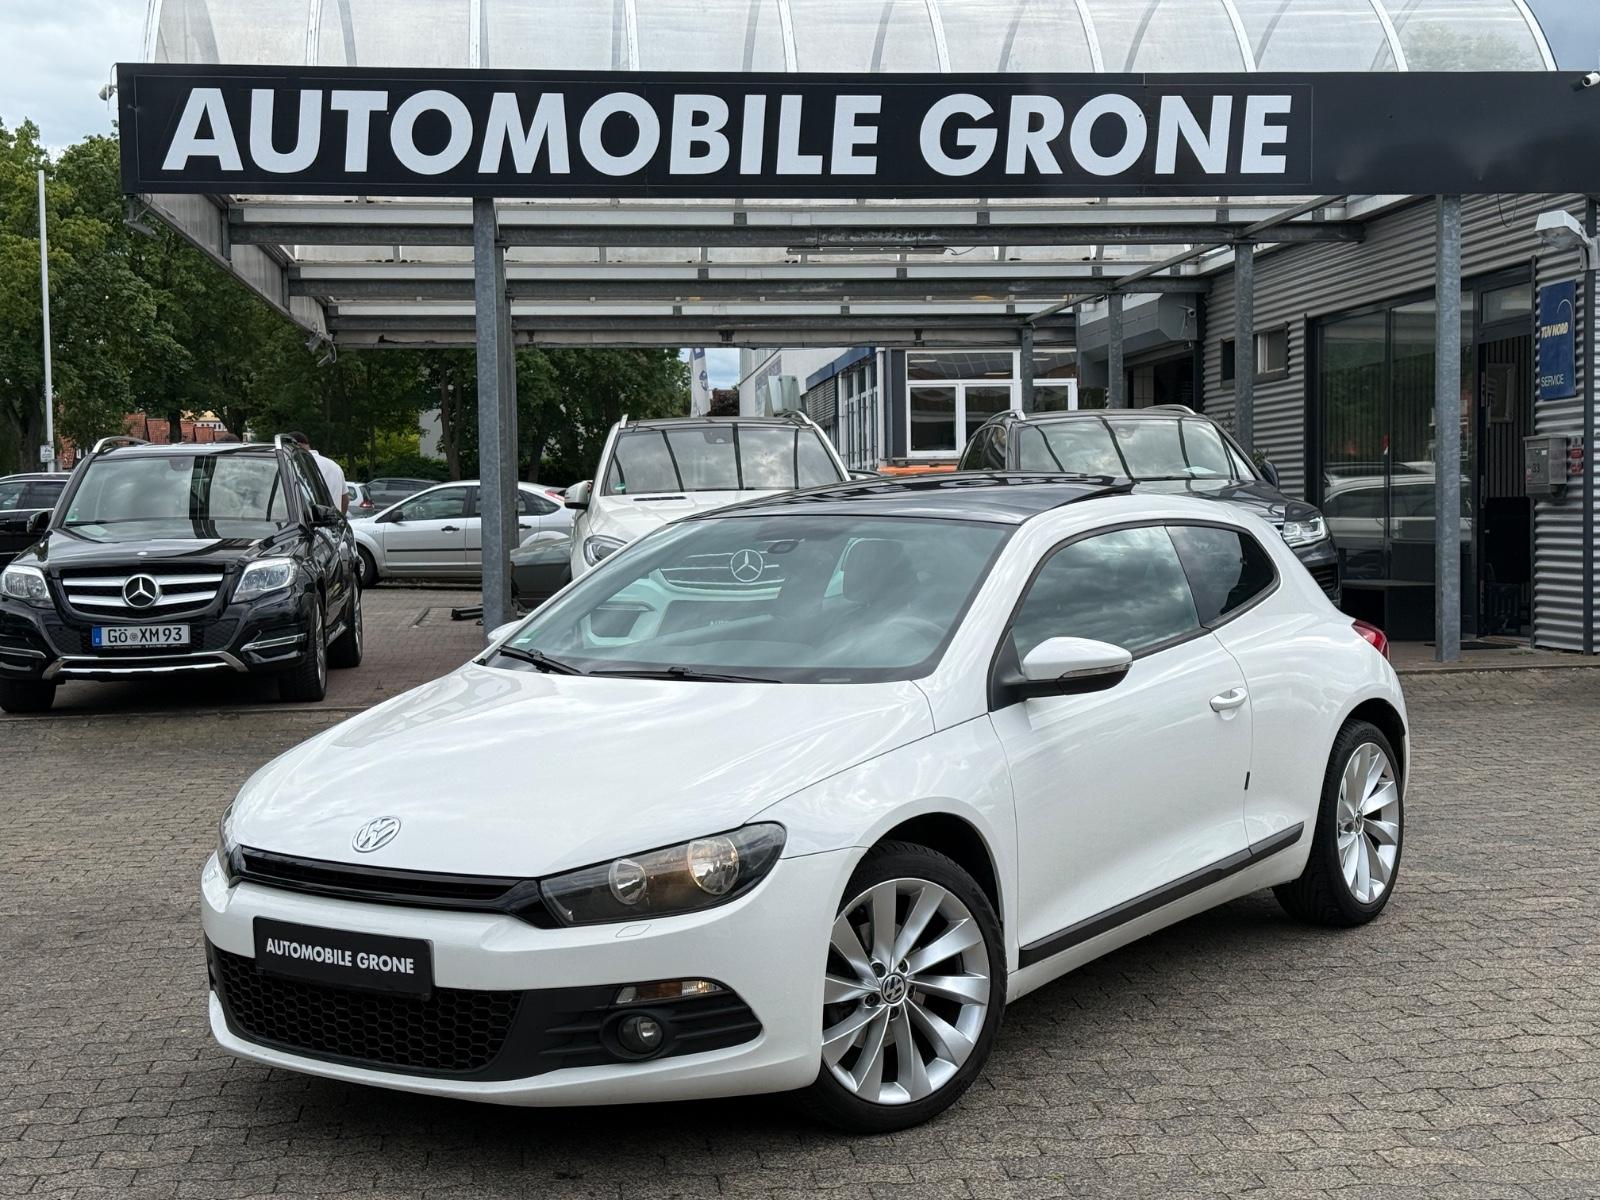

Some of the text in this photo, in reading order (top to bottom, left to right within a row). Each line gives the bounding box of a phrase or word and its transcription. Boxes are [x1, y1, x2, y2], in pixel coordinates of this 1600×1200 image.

[161, 87, 1292, 177] AUTOMOBILE GRONE
[1541, 374, 1564, 387] SERVICE
[107, 627, 182, 644] GÖ XM 93
[266, 938, 415, 975] AUTOMOBILE GRONE
